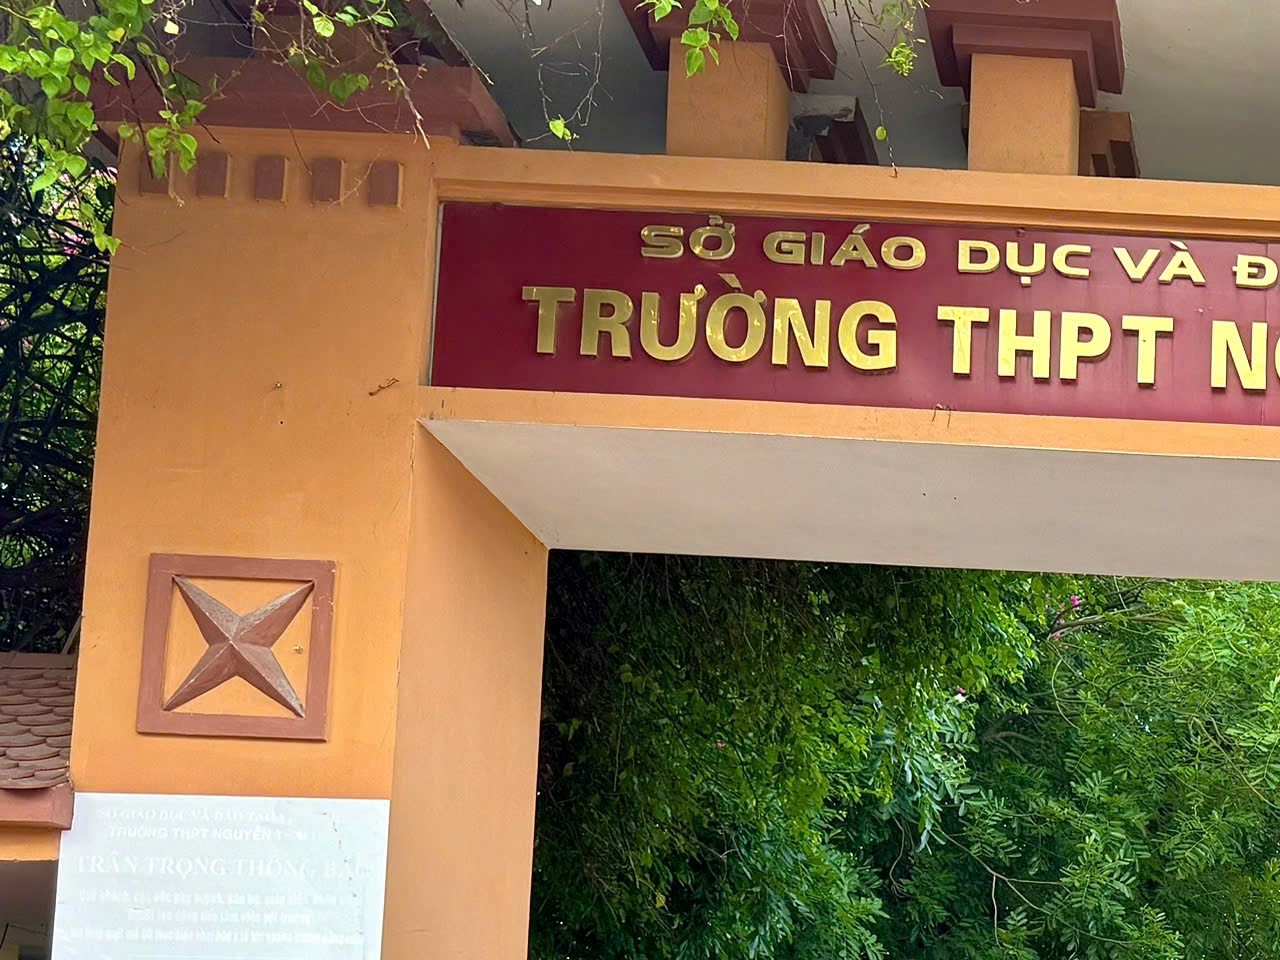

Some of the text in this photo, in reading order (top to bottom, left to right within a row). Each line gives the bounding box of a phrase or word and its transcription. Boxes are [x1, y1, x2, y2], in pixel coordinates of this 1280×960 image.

[640, 215, 736, 260] SỞ
[763, 223, 928, 271] GIÁO
[956, 239, 1092, 287] DỤC
[1113, 241, 1206, 287] VÀ
[521, 273, 899, 372] TRƯỜNG
[936, 304, 1175, 388] THPT
